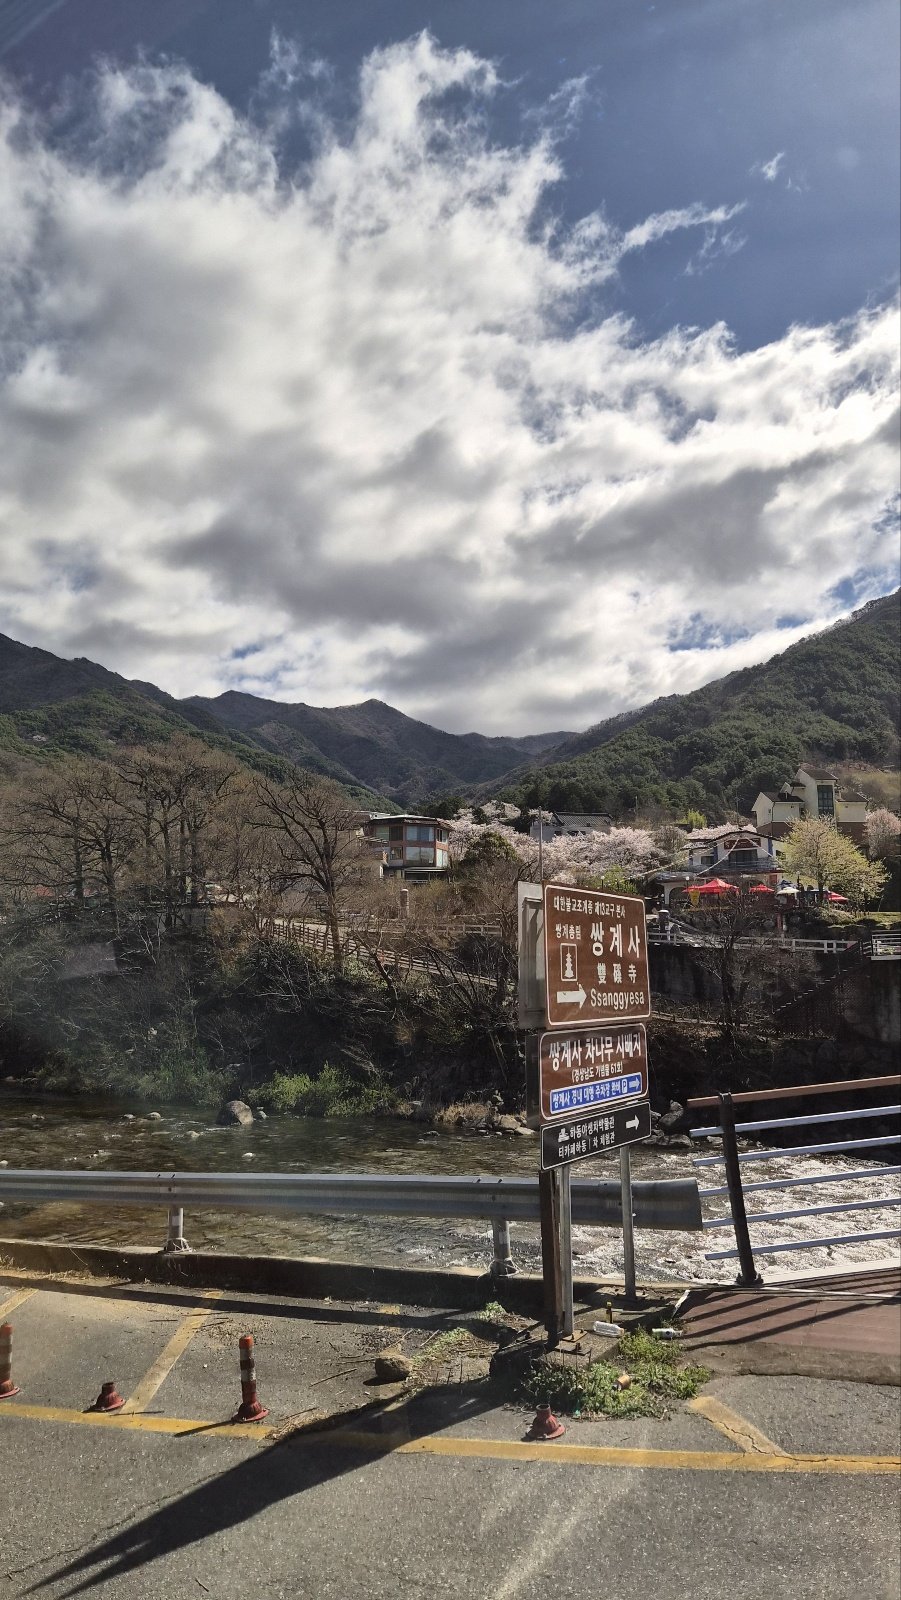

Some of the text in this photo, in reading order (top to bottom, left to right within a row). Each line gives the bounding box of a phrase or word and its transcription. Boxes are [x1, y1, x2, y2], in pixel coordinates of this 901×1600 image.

[553, 896, 626, 919] 대한불교조계종 제13교구 본사
[555, 923, 582, 940] 쌍계총림
[590, 921, 641, 958] 쌍계사
[590, 988, 645, 1010] Ssanggyesa
[549, 1032, 640, 1071] 쌍계사 차나무 시배지
[571, 1061, 623, 1083] (경상남도 기념물 61호)
[552, 1091, 570, 1109] 쌍계사
[595, 1081, 611, 1099] 주차장
[569, 1115, 616, 1140] 하동야생차박물관
[558, 1139, 588, 1159] 티카페하동
[599, 1131, 616, 1147] 체험관
